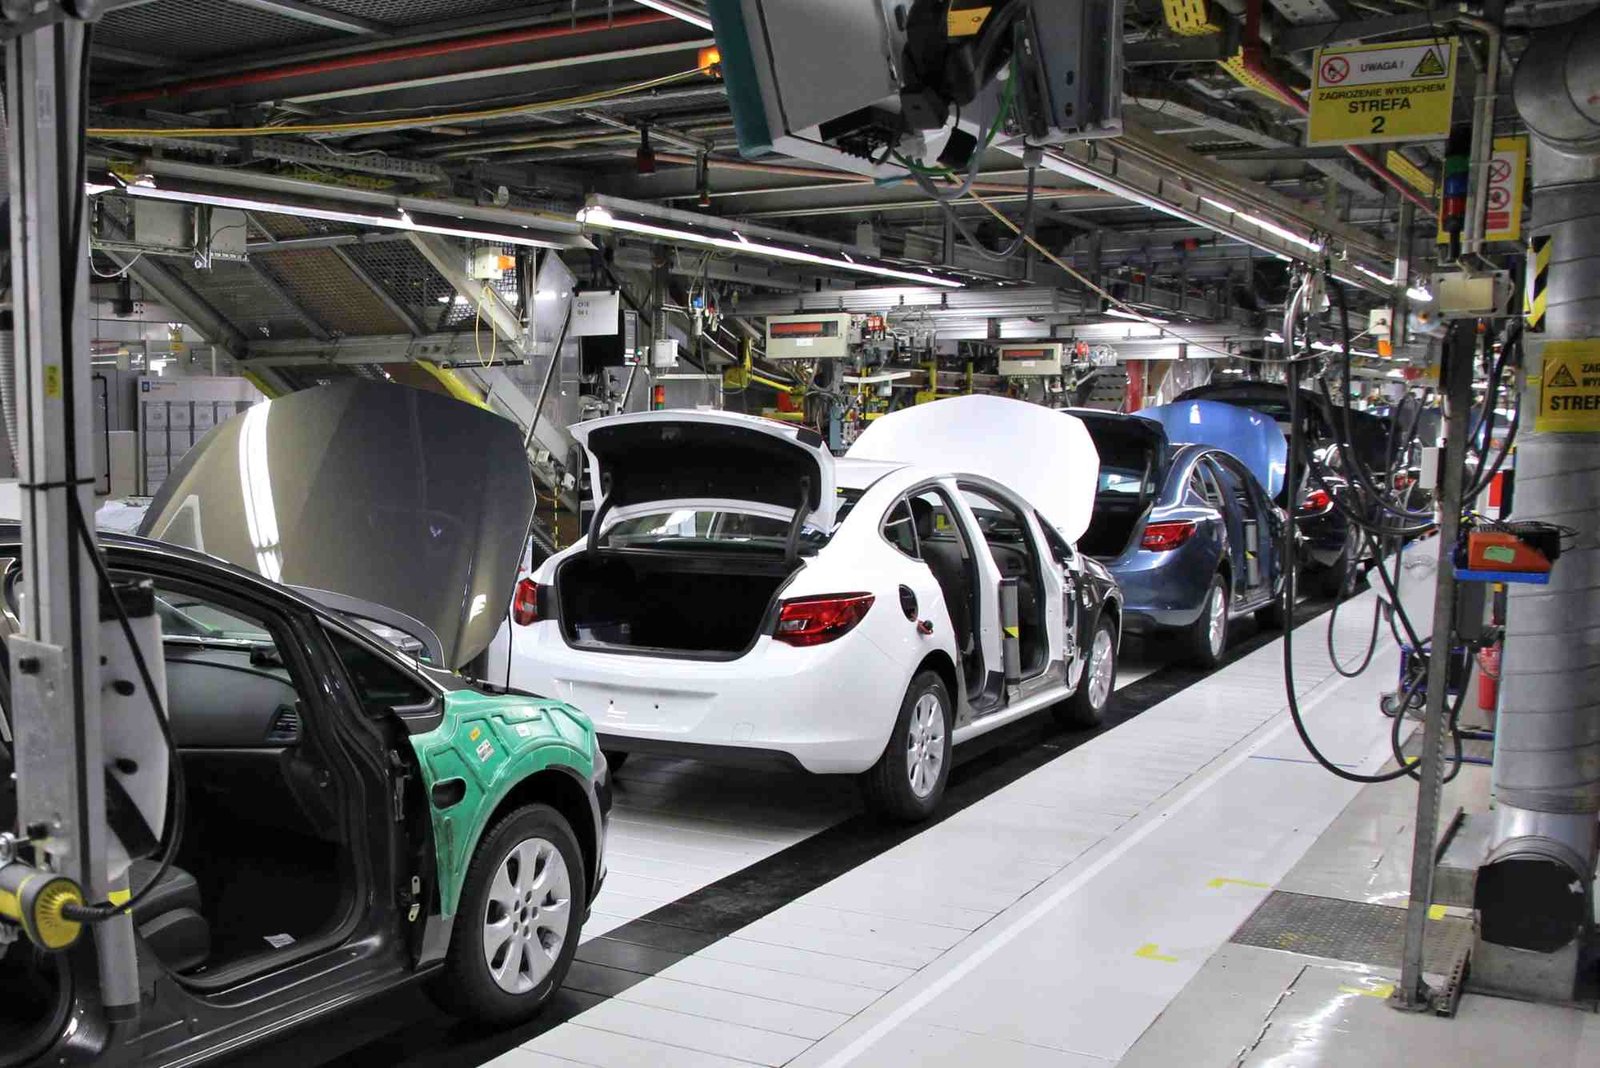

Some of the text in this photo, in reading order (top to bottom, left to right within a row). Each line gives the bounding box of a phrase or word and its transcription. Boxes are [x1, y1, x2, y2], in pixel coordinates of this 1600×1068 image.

[1360, 61, 1398, 73] UWAGA
[1385, 83, 1446, 96] WYBUCHEM
[1348, 98, 1411, 114] STREFA
[1371, 116, 1385, 135] 2
